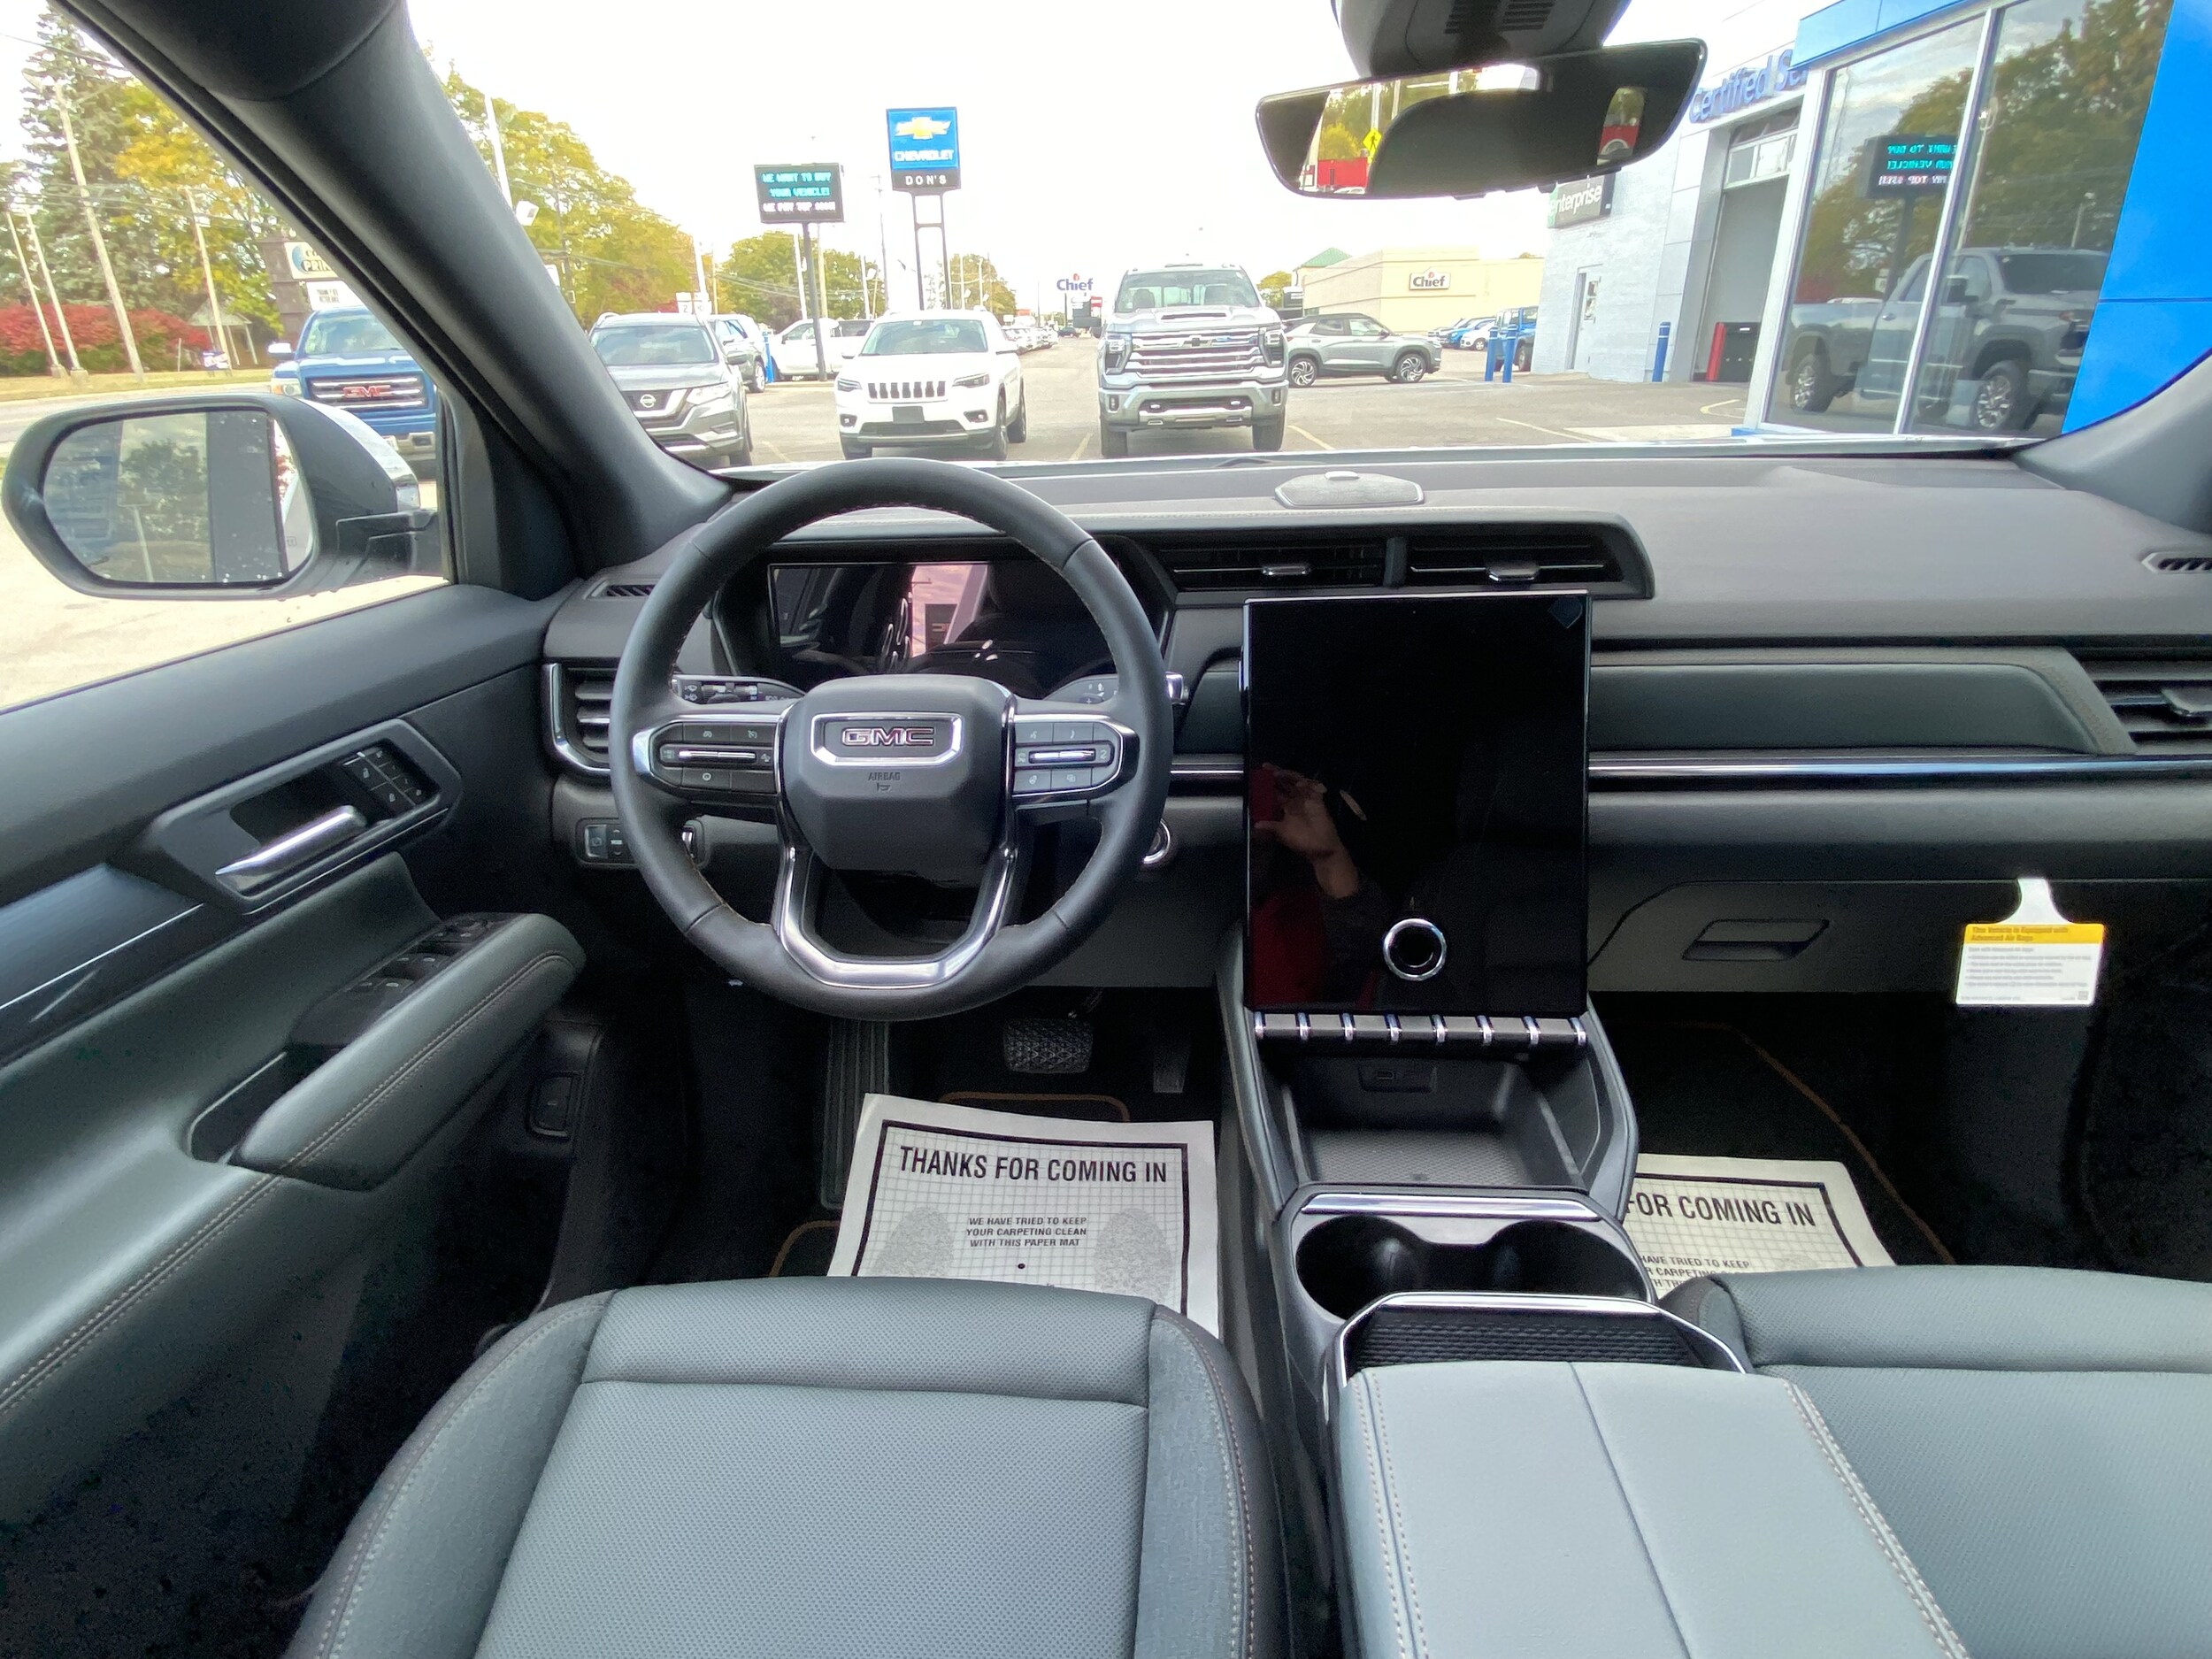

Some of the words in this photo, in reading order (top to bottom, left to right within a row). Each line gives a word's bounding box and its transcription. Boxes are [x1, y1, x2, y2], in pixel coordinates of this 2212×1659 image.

[1689, 55, 1773, 124] Certified
[894, 149, 954, 162] CHEVROLET
[905, 175, 947, 186] DON'S
[1056, 276, 1094, 291] Chief
[1413, 274, 1446, 288] Chief
[342, 384, 391, 398] GMC
[842, 728, 934, 746] GMC
[867, 772, 901, 781] AIRBAG
[900, 1145, 987, 1179] THANKS
[995, 1156, 1039, 1180] FOR
[1048, 1159, 1136, 1182] COMING
[1146, 1162, 1166, 1182] IN
[1678, 1195, 1781, 1225] COMING
[1786, 1202, 1816, 1226] IN
[1015, 1217, 1044, 1225] TRIED
[1047, 1217, 1060, 1225] TO
[1063, 1217, 1087, 1225] KEEP
[996, 1227, 1052, 1236] CARPETING
[1056, 1227, 1087, 1236] CLEAN
[970, 1239, 995, 1248] WITH
[1670, 1256, 1702, 1267] TRIED
[1704, 1258, 1720, 1268] TO
[1722, 1259, 1750, 1269] KEEP
